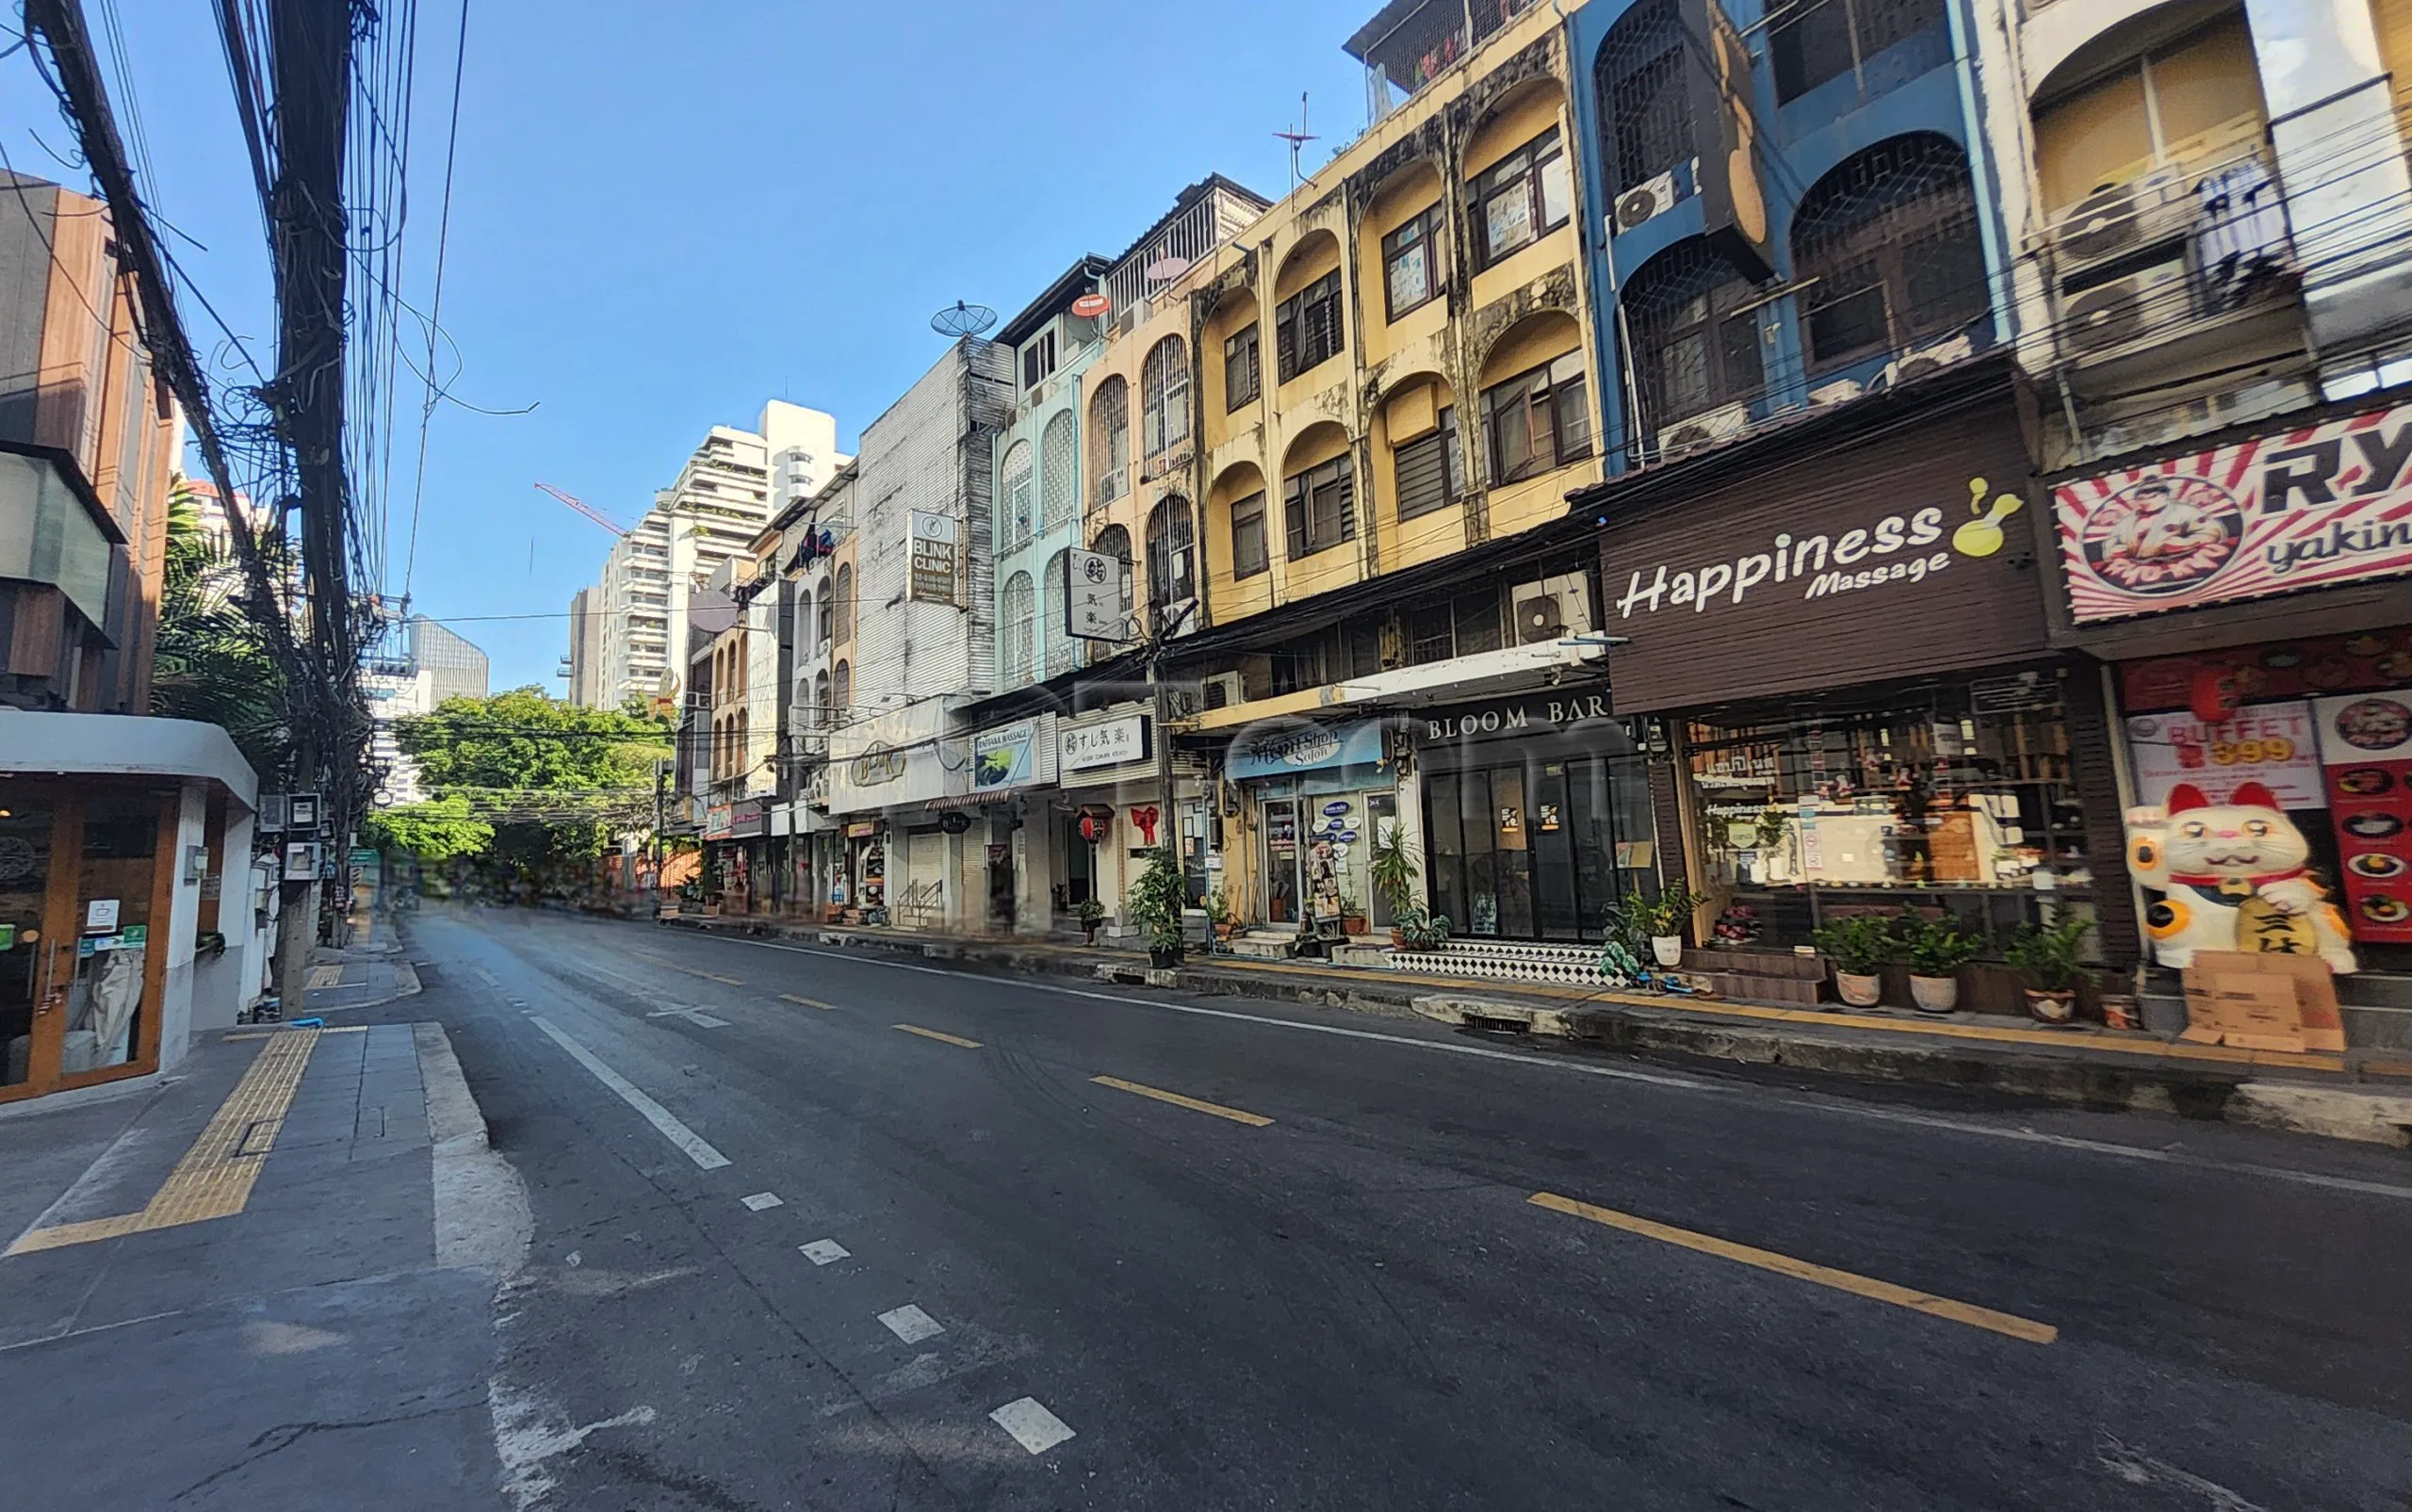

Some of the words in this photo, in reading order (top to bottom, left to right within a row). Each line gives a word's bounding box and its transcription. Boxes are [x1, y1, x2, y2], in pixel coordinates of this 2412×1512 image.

[913, 540, 952, 561] BLINK
[914, 556, 952, 574] CLINIC
[1616, 507, 1944, 619] Happiness
[2267, 520, 2412, 574] yakin
[1803, 552, 1951, 600] Massage
[1427, 706, 1528, 740] BLOOM
[1547, 694, 1608, 724] BAR
[2169, 716, 2305, 745] BUFFET
[1705, 803, 1768, 819] Happiness
